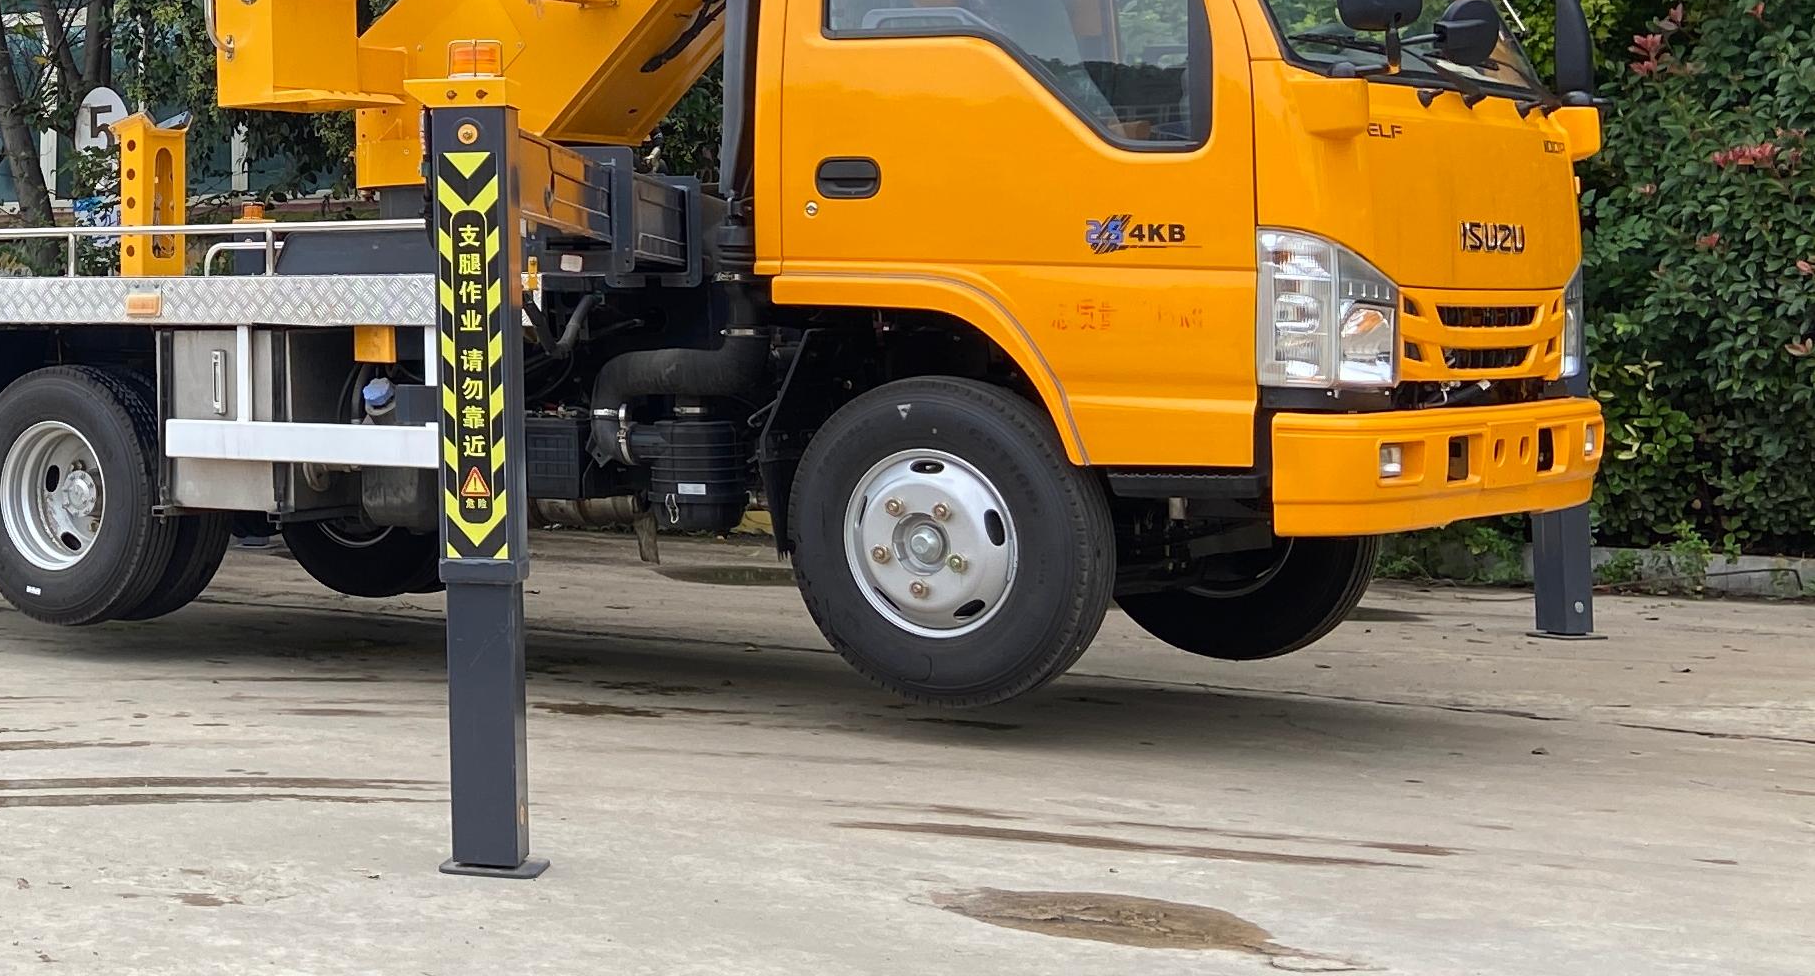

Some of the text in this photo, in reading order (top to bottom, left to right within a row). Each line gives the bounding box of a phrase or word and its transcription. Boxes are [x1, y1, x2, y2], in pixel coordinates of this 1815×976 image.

[1367, 122, 1403, 139] ELF
[1128, 223, 1186, 243] 4KB
[1460, 220, 1526, 254] ISUZU
[458, 224, 486, 458] 支腿作业 请勿靠近
[465, 497, 488, 510] 危险
